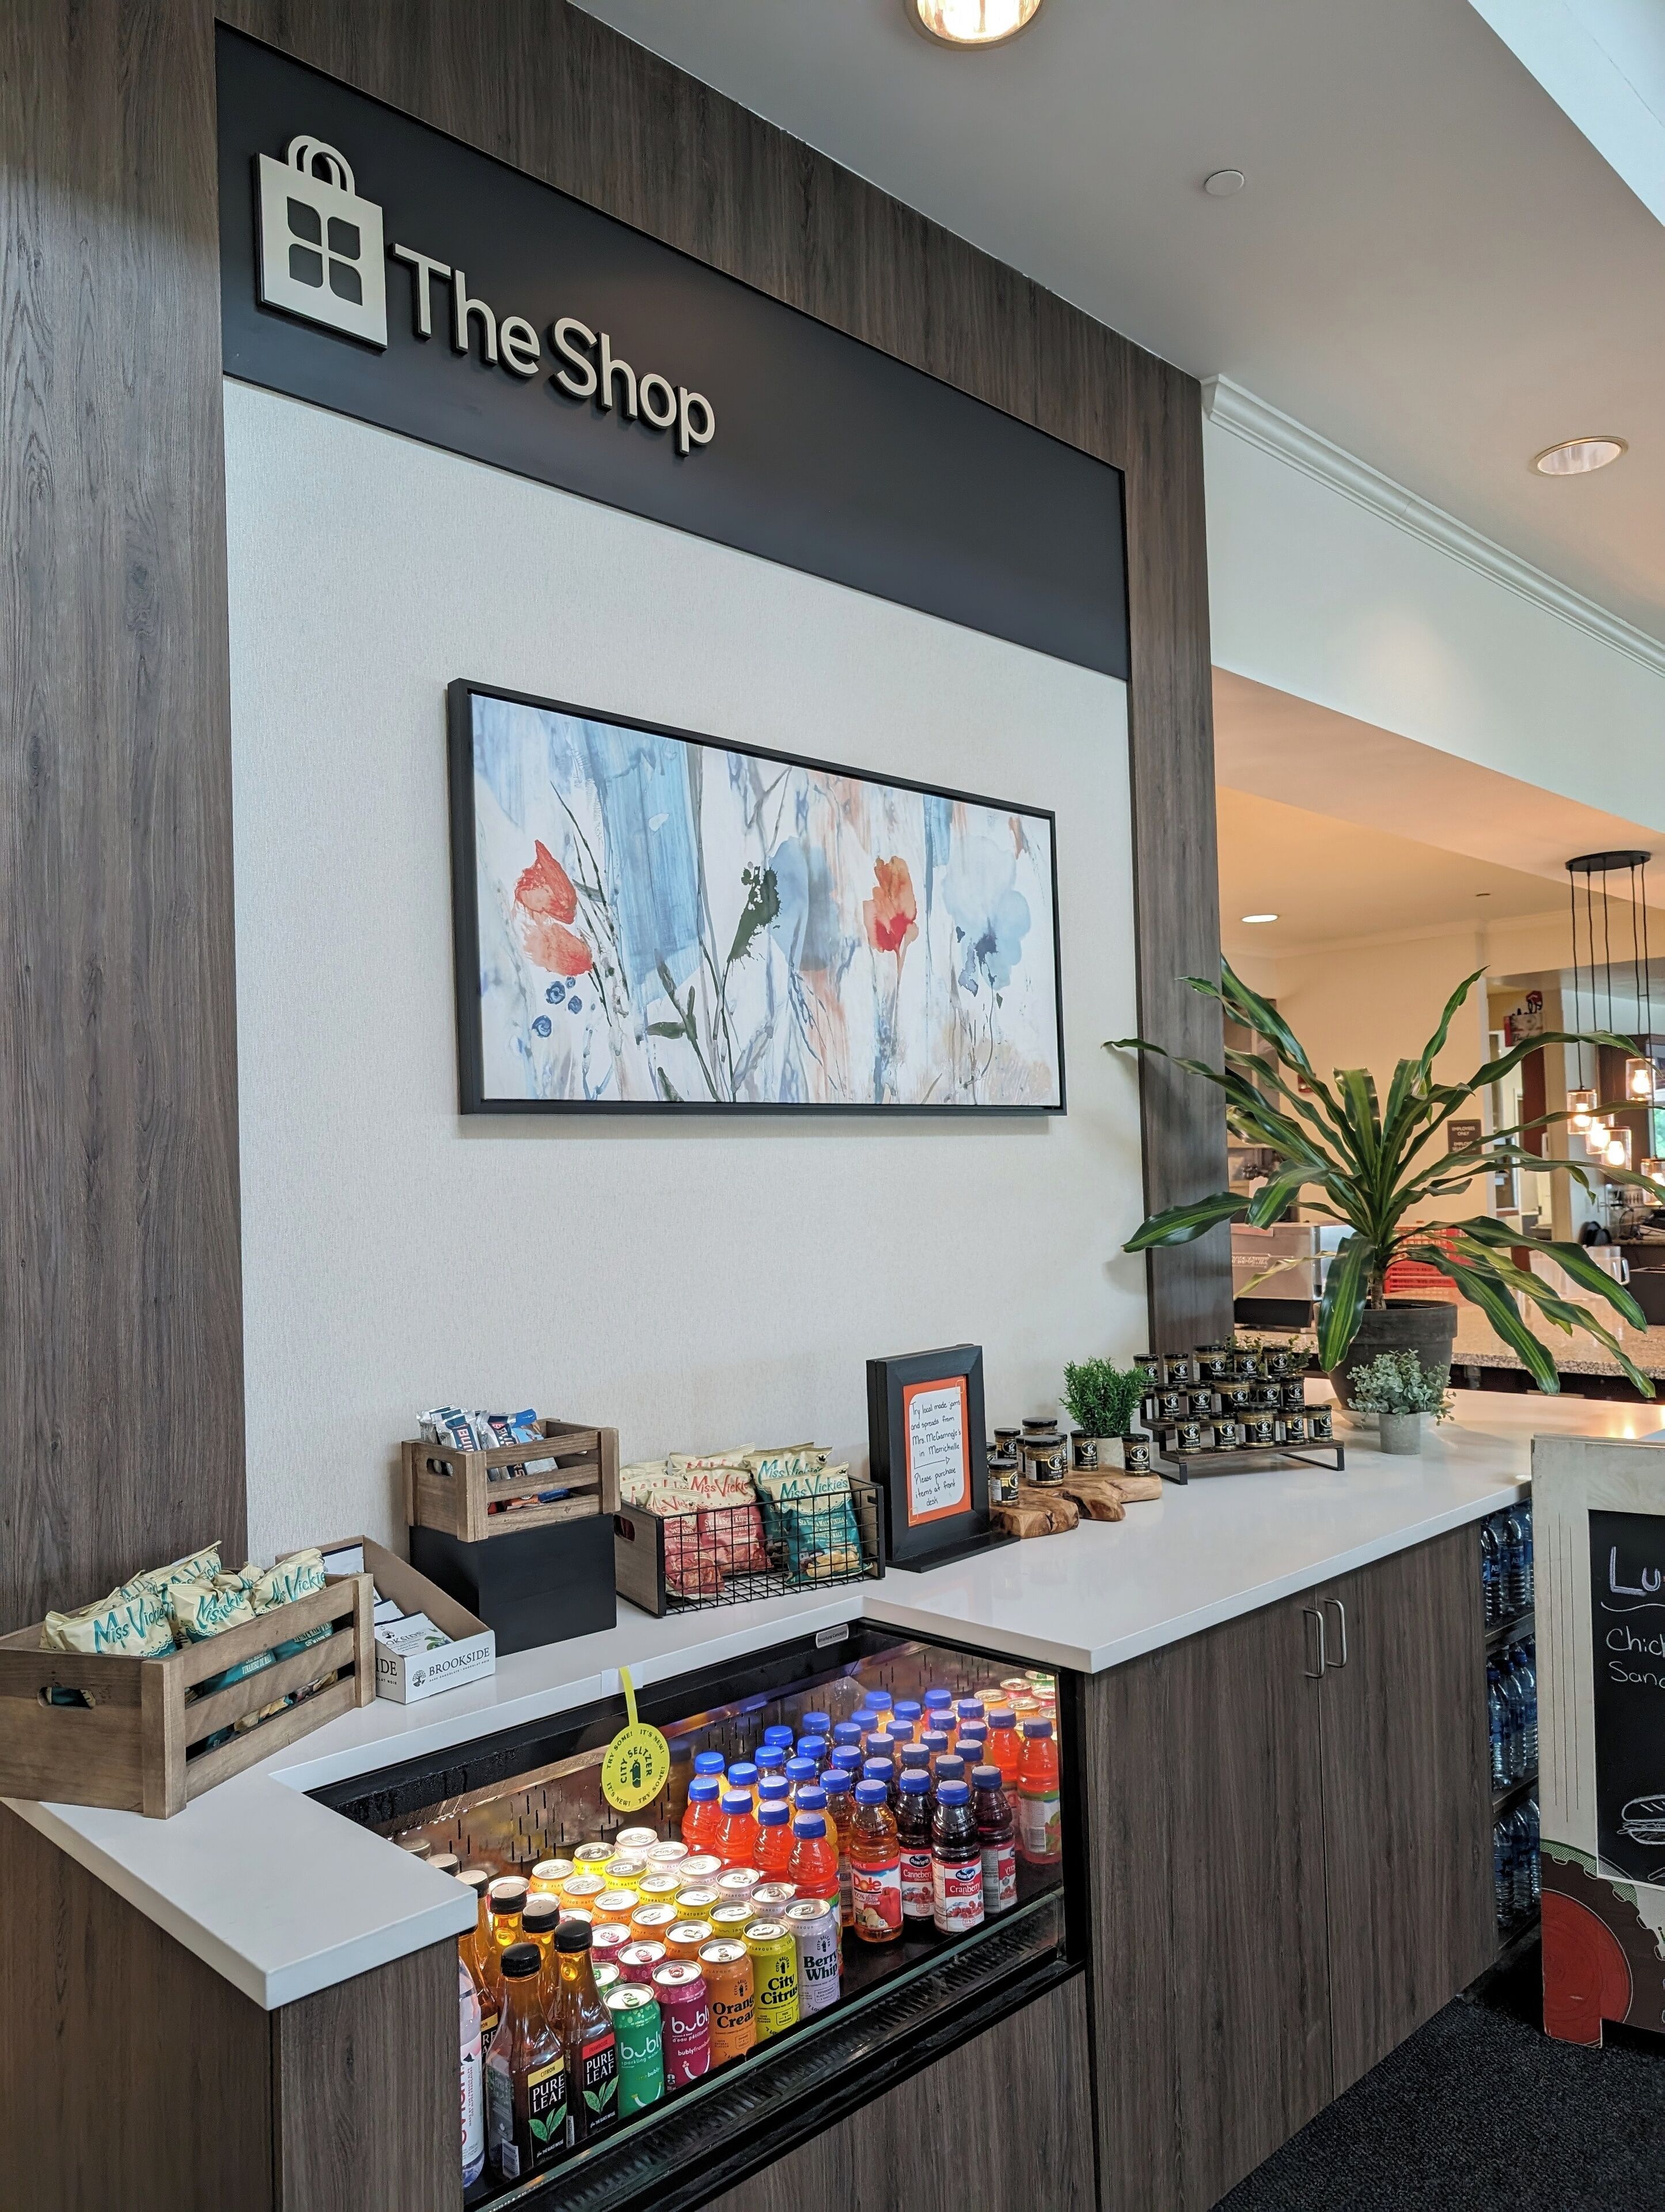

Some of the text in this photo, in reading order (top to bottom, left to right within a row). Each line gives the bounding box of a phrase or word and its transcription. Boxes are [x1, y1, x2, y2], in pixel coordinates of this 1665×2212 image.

[390, 242, 716, 457] The Shop
[910, 1399, 961, 1419] Try local made jams
[911, 1415, 954, 1431] and spreads from
[912, 1434, 926, 1446] Mrs.
[928, 1442, 959, 1456] Merrickville
[757, 1459, 785, 1485] Miss
[914, 1467, 956, 1485] Please purchase
[691, 1475, 715, 1498] Miss
[780, 1474, 848, 1505] Miss Vickie's
[915, 1478, 956, 1499] items at front
[926, 1497, 939, 1507] desk
[93, 1611, 130, 1654] Miss
[386, 1631, 424, 1646] OKSIDE
[428, 1647, 490, 1677] BROOKSIDE
[439, 1669, 460, 1679] CHOCOLATE
[462, 1662, 481, 1671] CHOCOLAT
[606, 1730, 633, 1770] TRY SOME!
[639, 1729, 665, 1755] IT'S NEW!
[620, 1745, 653, 1784] CITY SELTZER
[606, 1781, 631, 1807] IT'S NEW!
[638, 1766, 666, 1804] TRY SOME!
[911, 1858, 930, 1866] Ocean Spray
[853, 1873, 882, 1891] Dole
[966, 1870, 975, 1880] Spray
[950, 1883, 980, 1895] Cranberry
[803, 1949, 838, 1968] Berry
[767, 1974, 795, 1991] City
[805, 1963, 838, 1982] Whip
[712, 1994, 755, 2016] Orang
[760, 1984, 798, 2005] Citrus
[671, 2004, 711, 2034] bubly
[620, 2030, 662, 2061] bubly
[540, 2065, 556, 2078] CITRON
[586, 2048, 615, 2074] PURE
[621, 2056, 647, 2066] sparkling
[586, 2060, 615, 2086] LEAF
[532, 2073, 565, 2101] PURE
[532, 2085, 565, 2113] LEAF
